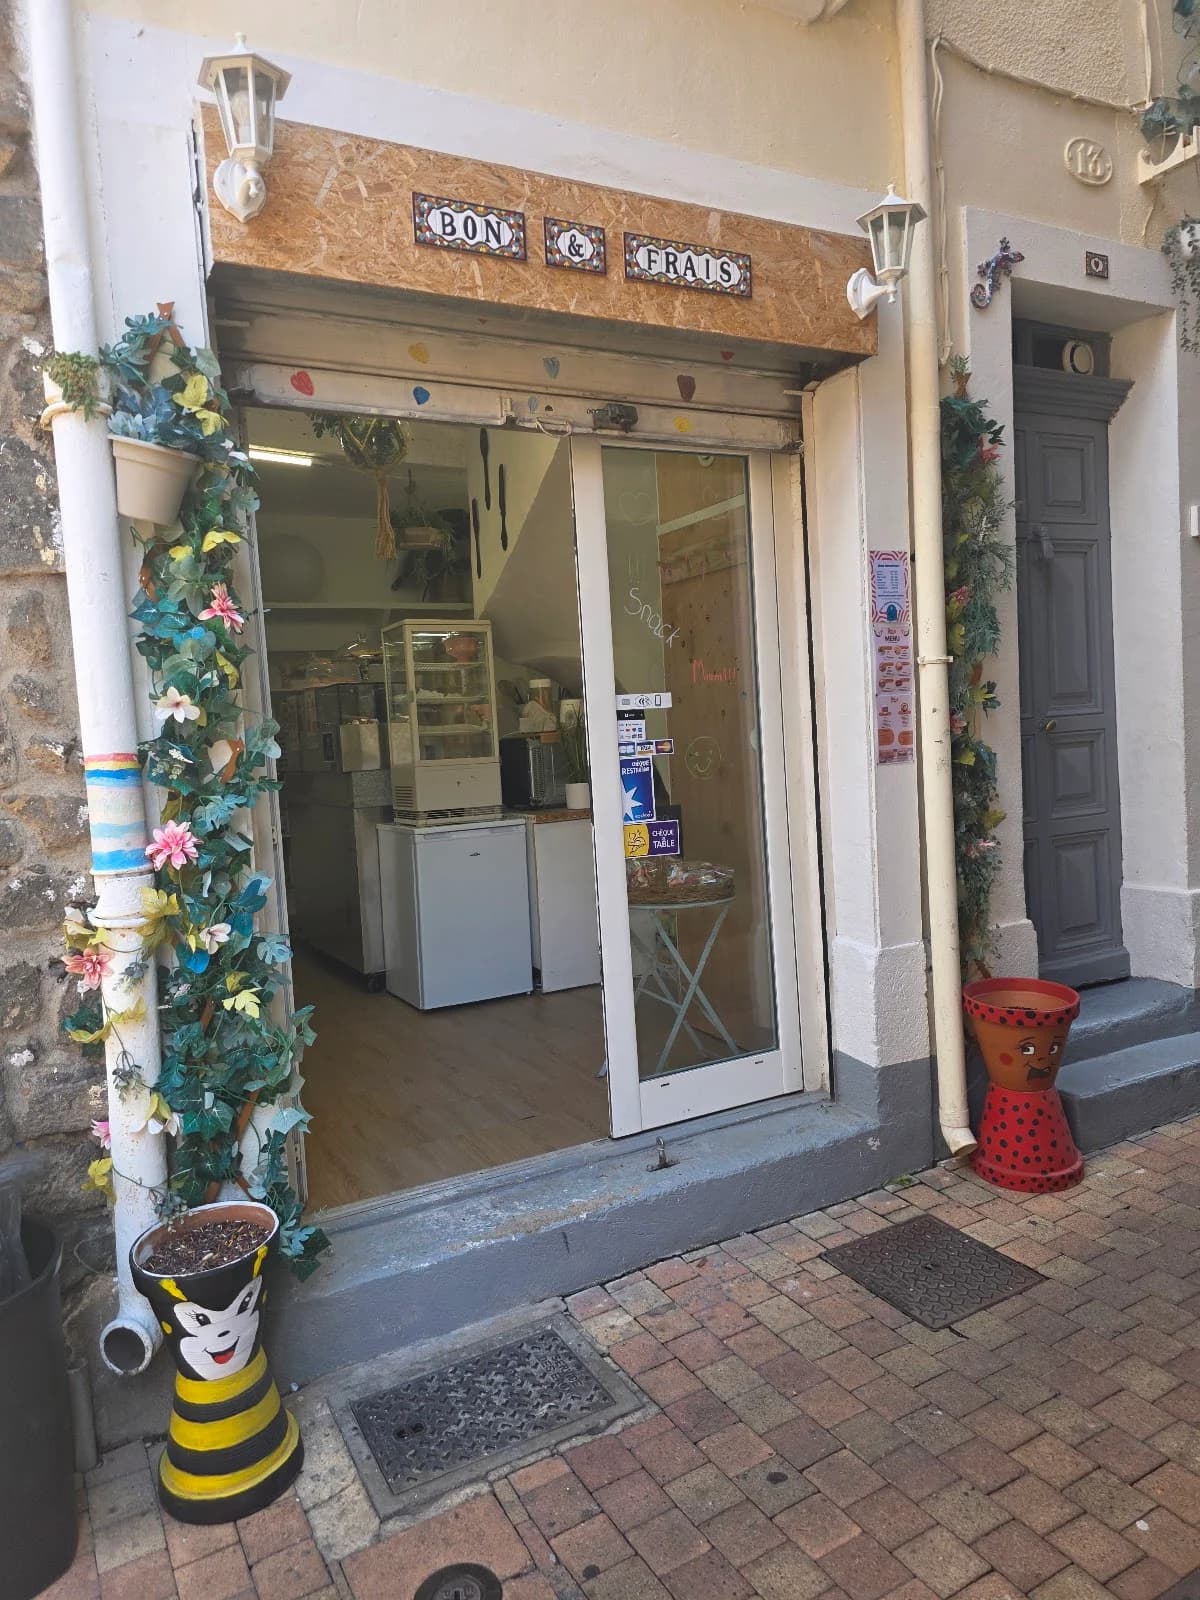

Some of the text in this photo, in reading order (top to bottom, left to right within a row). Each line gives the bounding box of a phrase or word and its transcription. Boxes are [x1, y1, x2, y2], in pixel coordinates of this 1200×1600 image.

[439, 211, 733, 283] BON & FRAIS
[623, 587, 680, 649] Snack
[652, 839, 675, 849] TABLE
